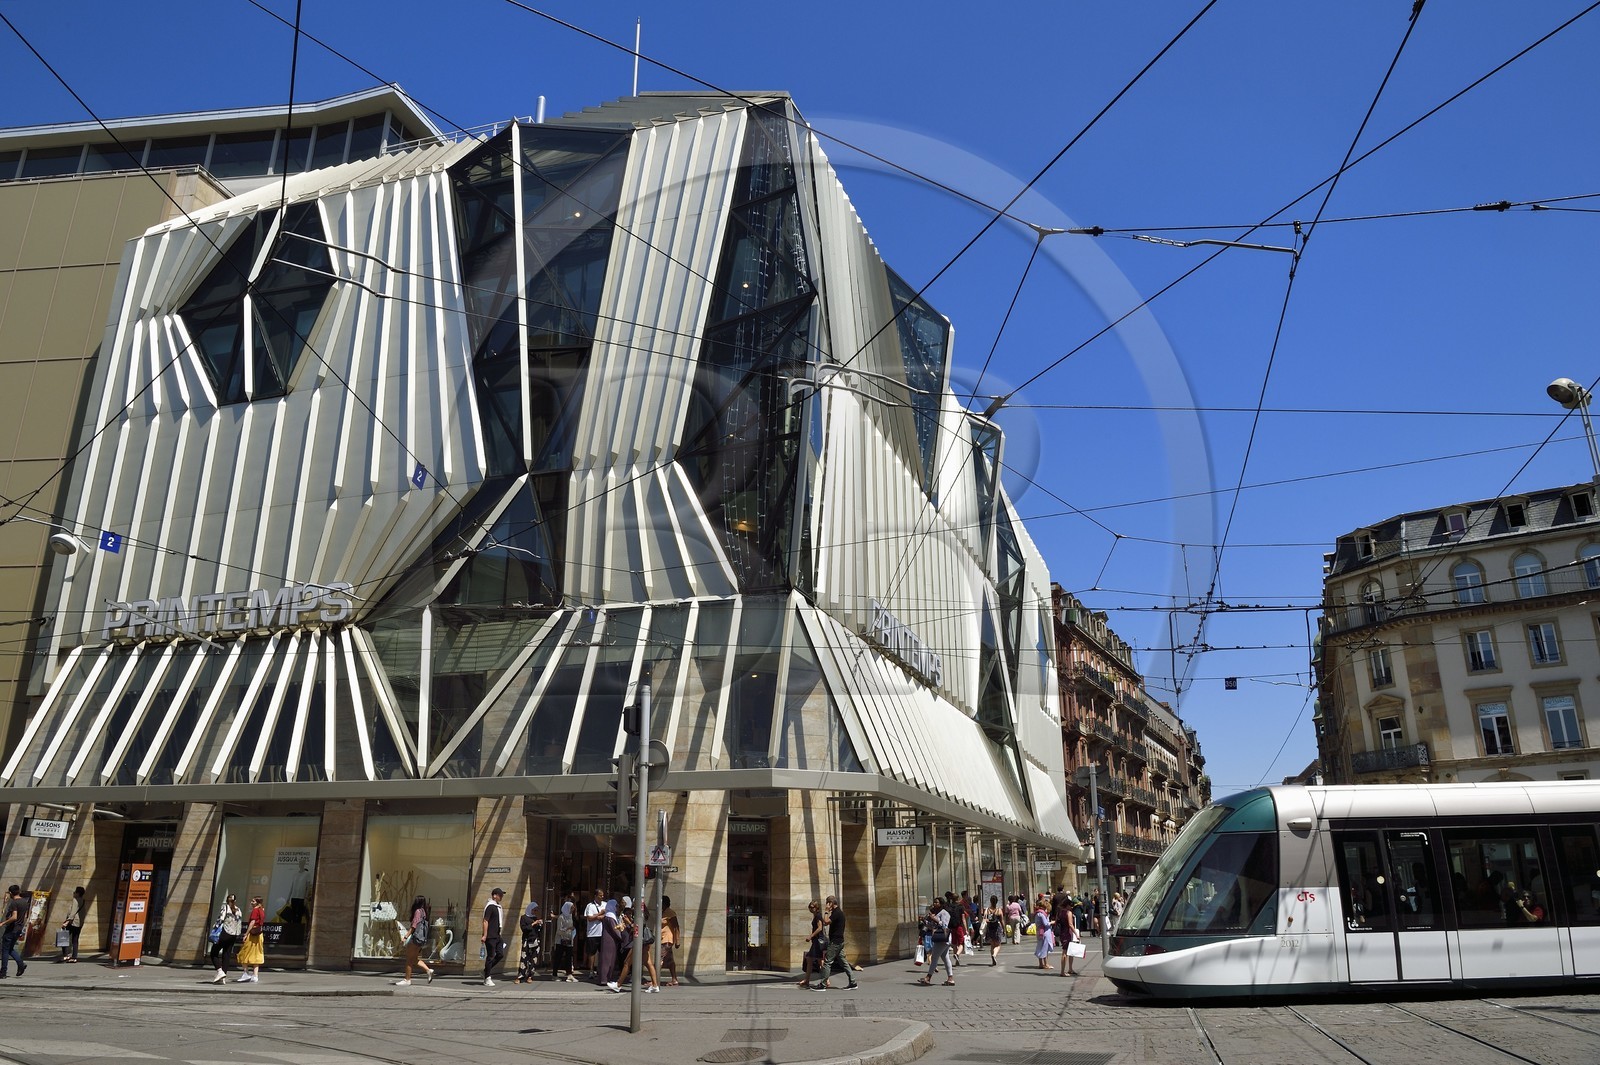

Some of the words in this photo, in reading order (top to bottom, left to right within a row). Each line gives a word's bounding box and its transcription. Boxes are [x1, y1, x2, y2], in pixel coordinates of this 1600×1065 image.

[417, 470, 423, 482] 2
[107, 536, 115, 547] 2
[101, 582, 354, 641] PRINTEMPS
[866, 597, 943, 688] PRINTEMPS
[1225, 680, 1237, 688] 350
[35, 821, 61, 829] MAISONS
[570, 823, 637, 834] PRINTEMPS
